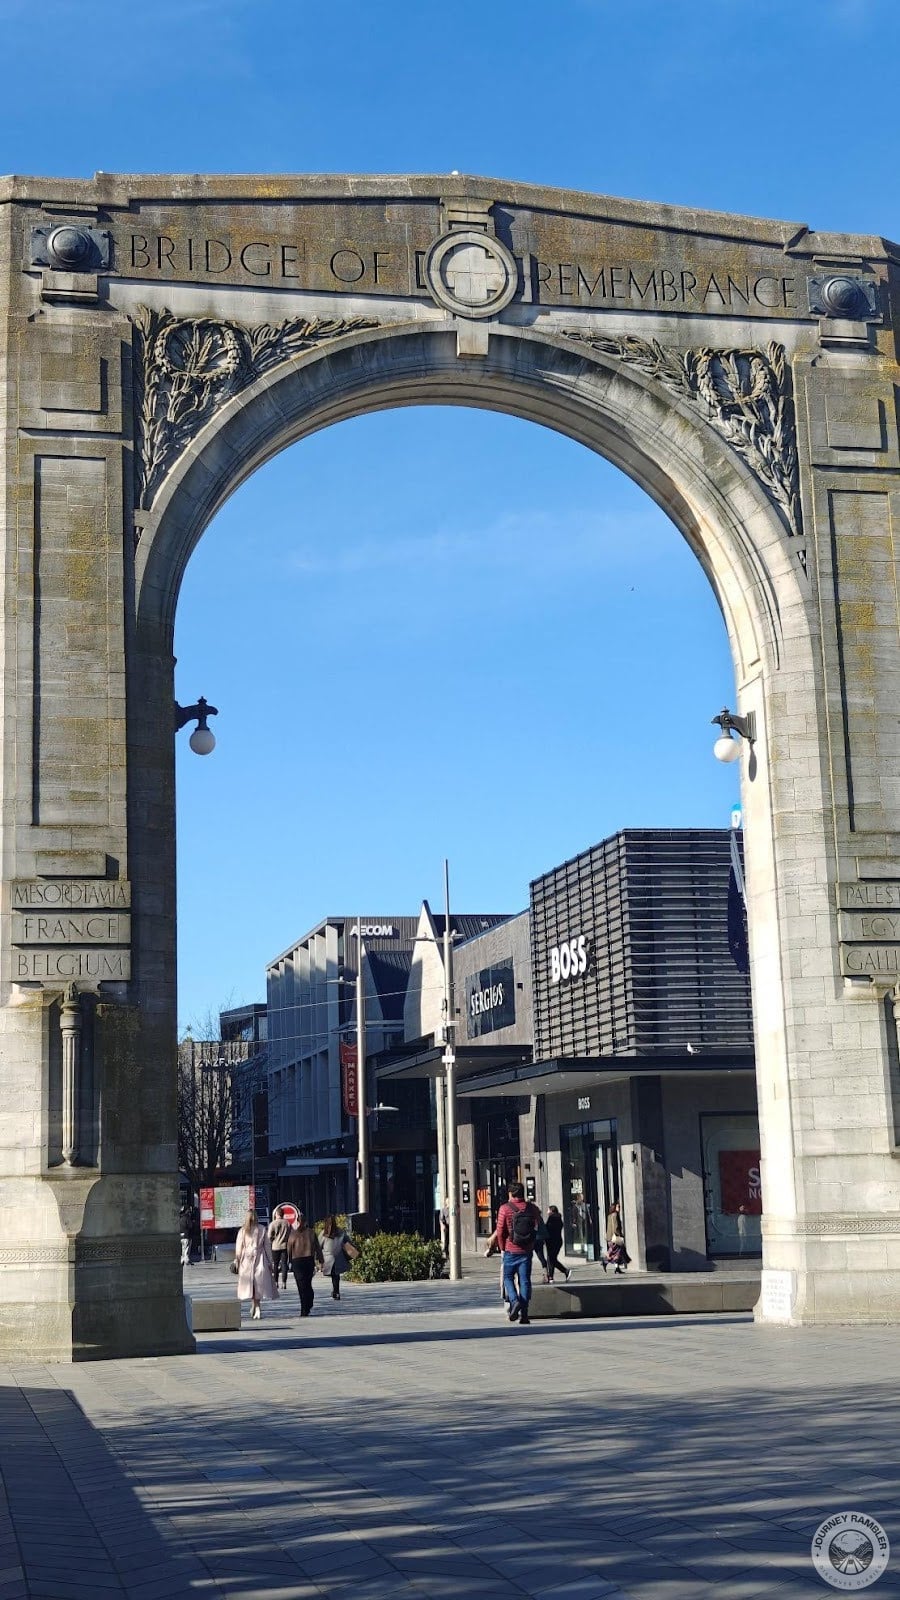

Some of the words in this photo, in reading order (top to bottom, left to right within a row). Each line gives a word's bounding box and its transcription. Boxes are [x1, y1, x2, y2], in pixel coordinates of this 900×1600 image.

[130, 234, 300, 279] BRIDGE
[329, 249, 390, 284] OF
[537, 261, 798, 310] REMEMBRANCE
[14, 884, 126, 905] MESOPOTAMIA
[24, 918, 118, 939] FRANCE
[349, 924, 393, 936] AECOM
[18, 953, 123, 976] BELGIUM
[551, 934, 587, 983] BOSS
[846, 949, 898, 971] GALLI
[347, 1062, 356, 1107] MARKET
